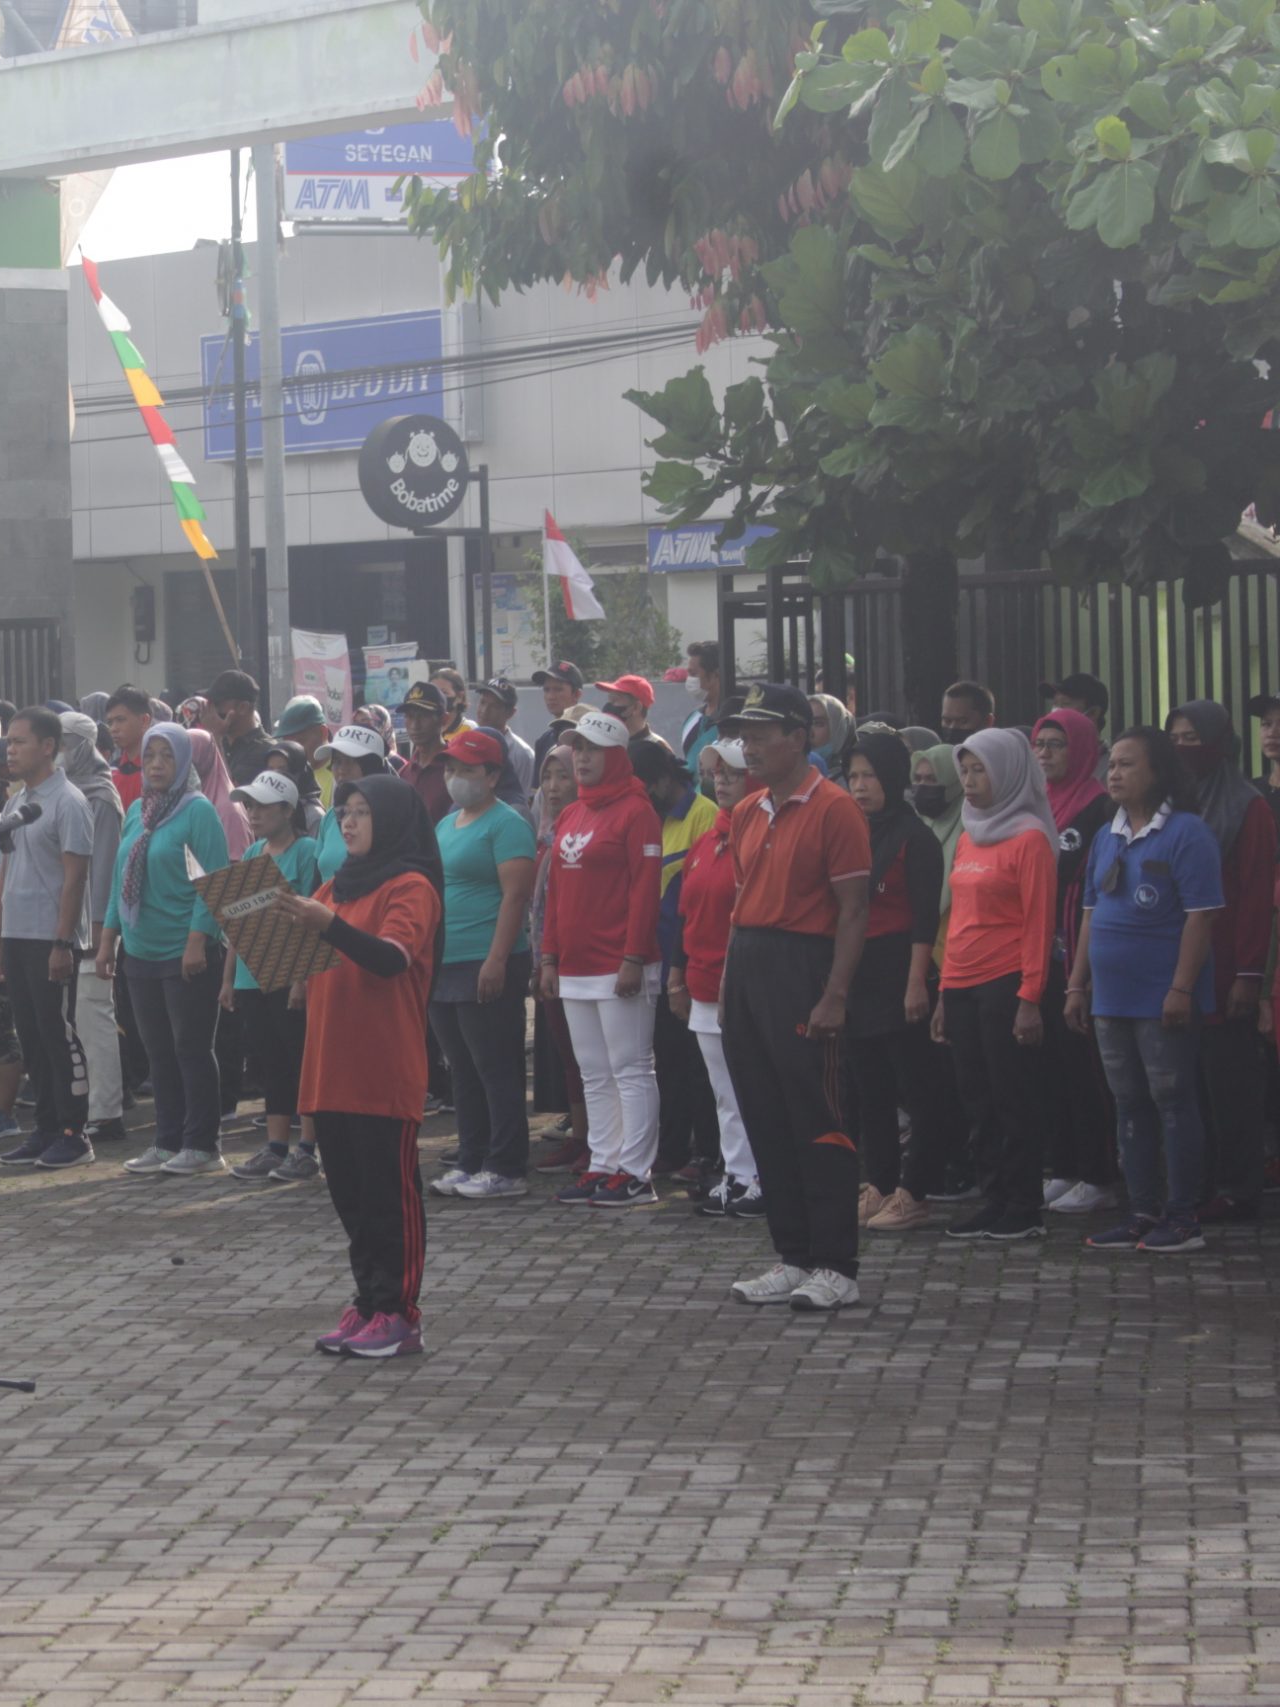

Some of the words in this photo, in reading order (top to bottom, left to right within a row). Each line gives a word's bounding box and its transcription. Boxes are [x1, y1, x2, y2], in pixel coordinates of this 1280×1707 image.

[345, 144, 433, 162] SEYEGAN
[295, 178, 370, 209] ATM
[389, 477, 460, 513] Bobatime
[651, 531, 720, 567] ATM
[228, 901, 252, 916] UUD
